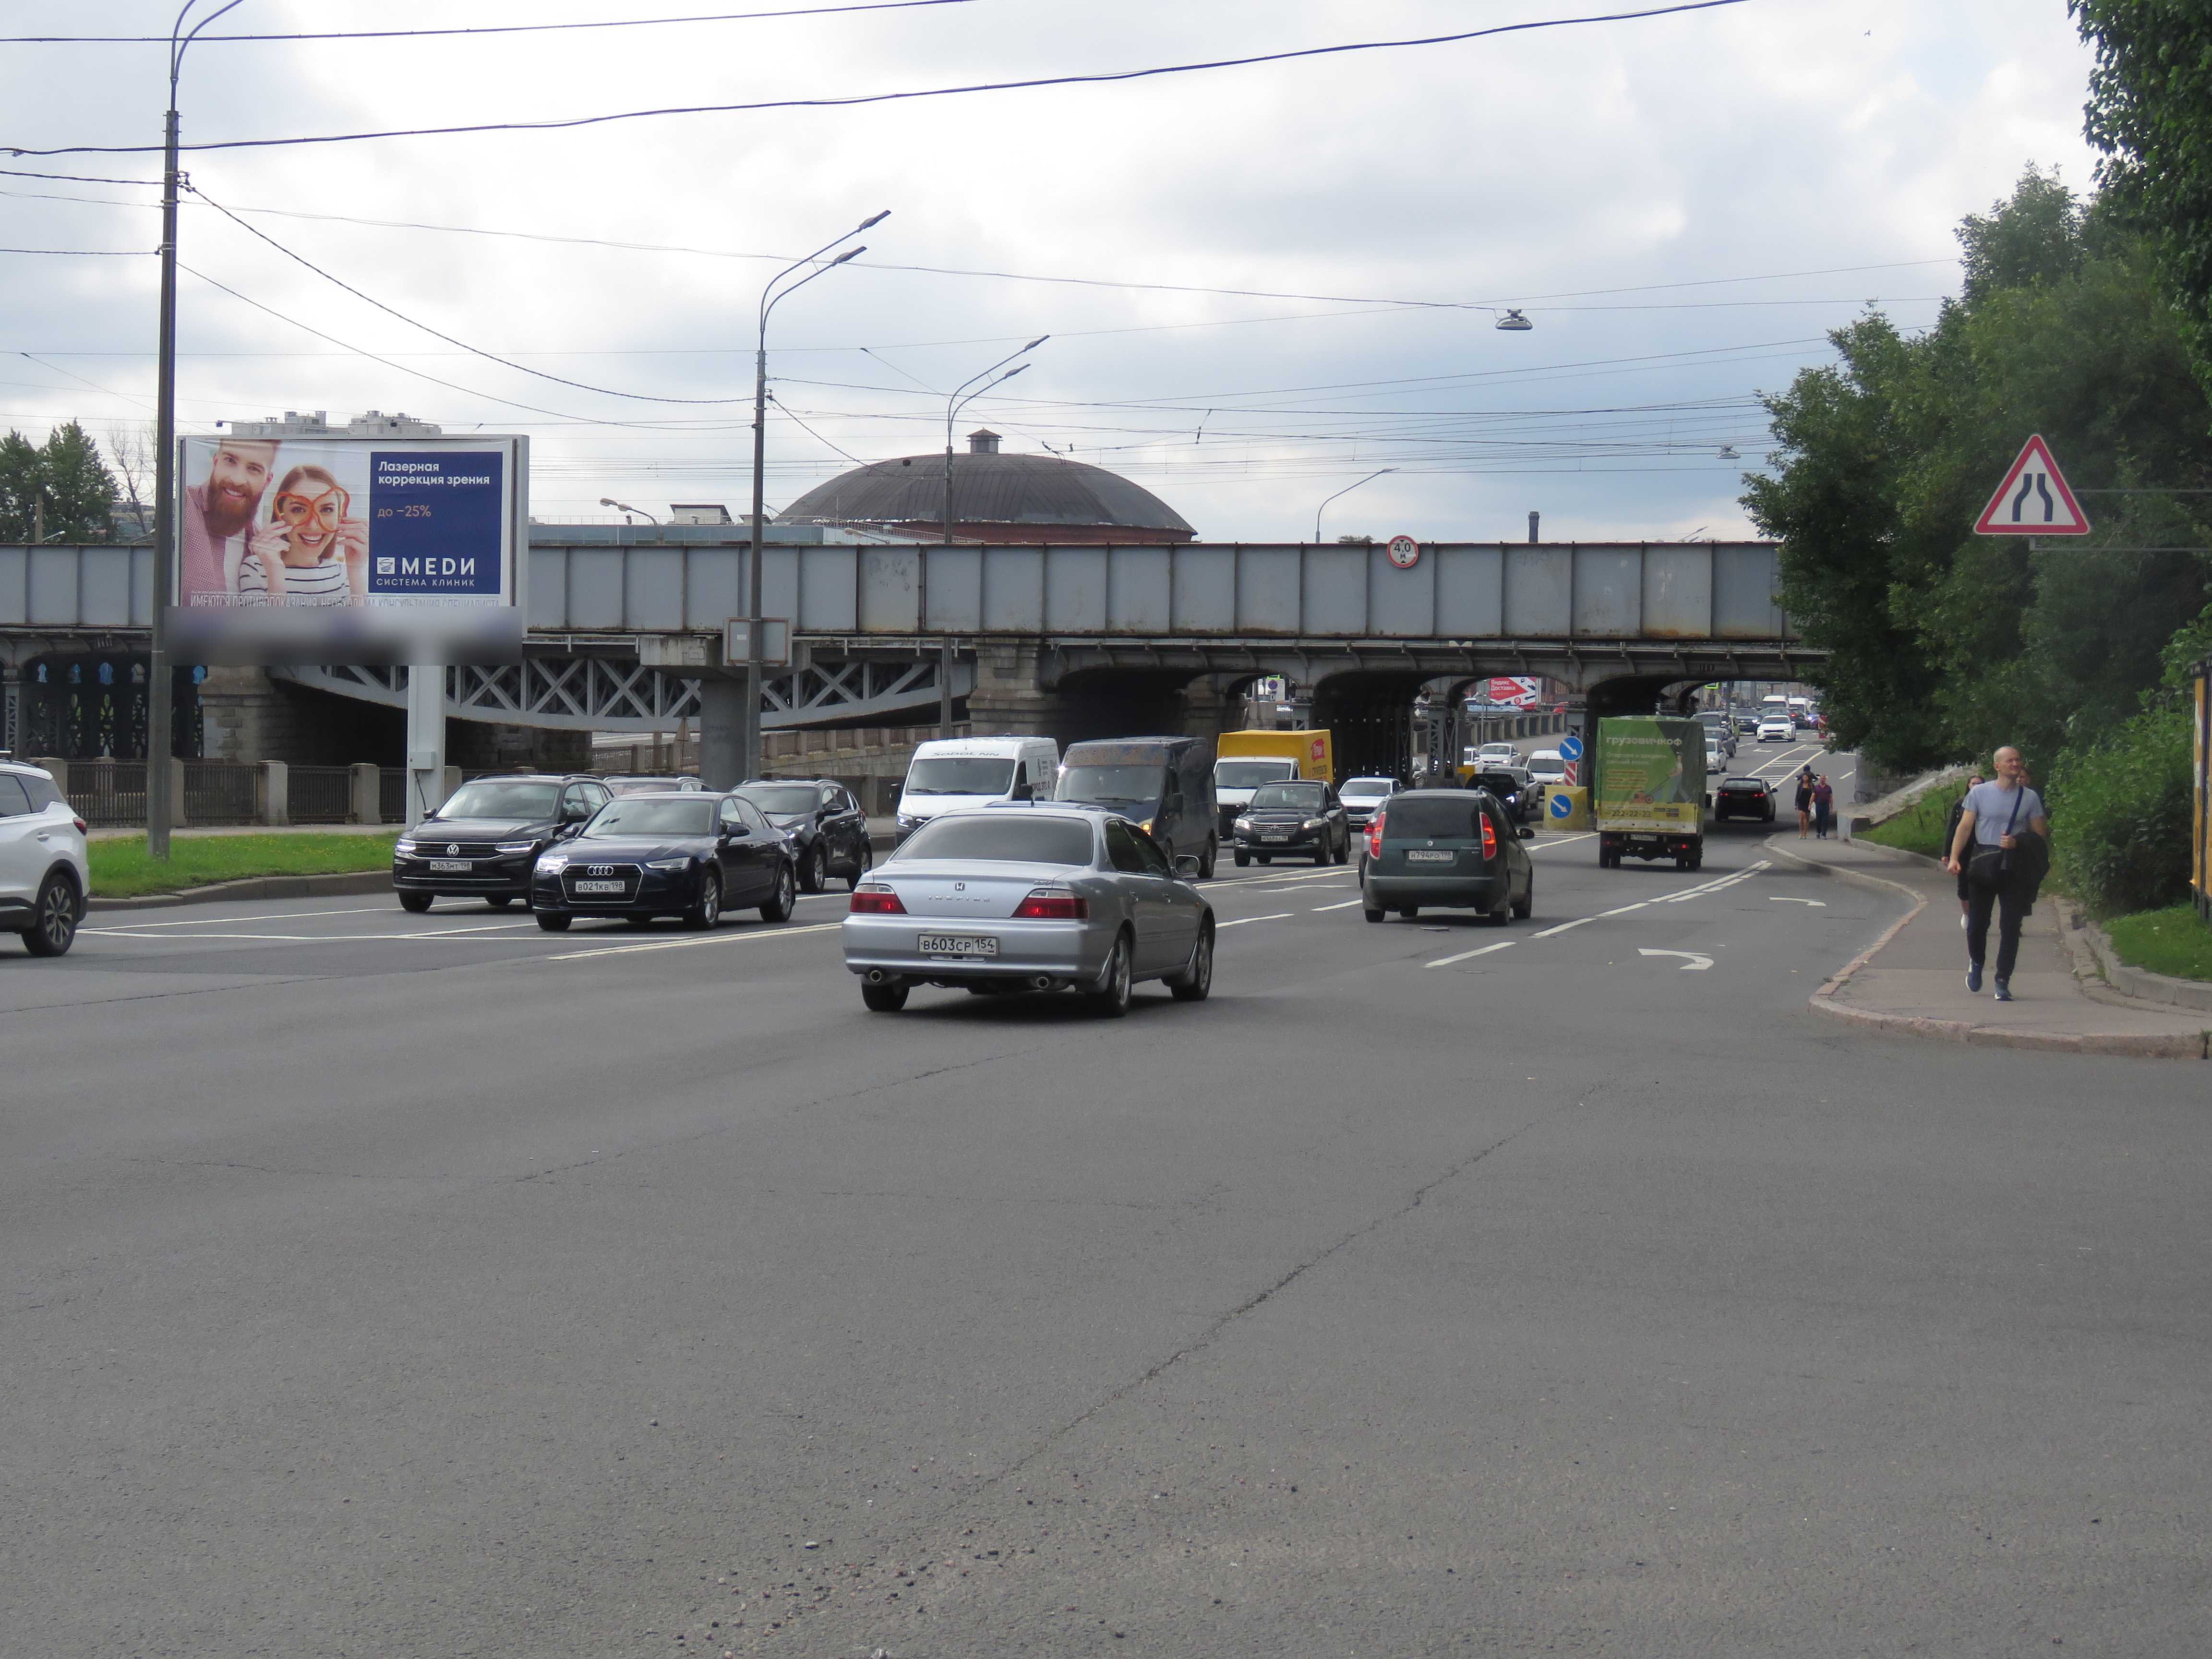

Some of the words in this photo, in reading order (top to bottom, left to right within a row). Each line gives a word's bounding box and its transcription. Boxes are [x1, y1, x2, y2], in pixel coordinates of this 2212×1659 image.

[378, 461, 439, 474] Лазерная
[378, 476, 444, 487] коррекция
[446, 476, 490, 487] зрения
[377, 508, 393, 518] до
[376, 578, 427, 586] СИСТЕМА
[1606, 737, 1682, 746] грузовичкоф
[578, 882, 609, 891] В021КВ
[923, 937, 972, 951] В603СР
[974, 938, 994, 949] 154
